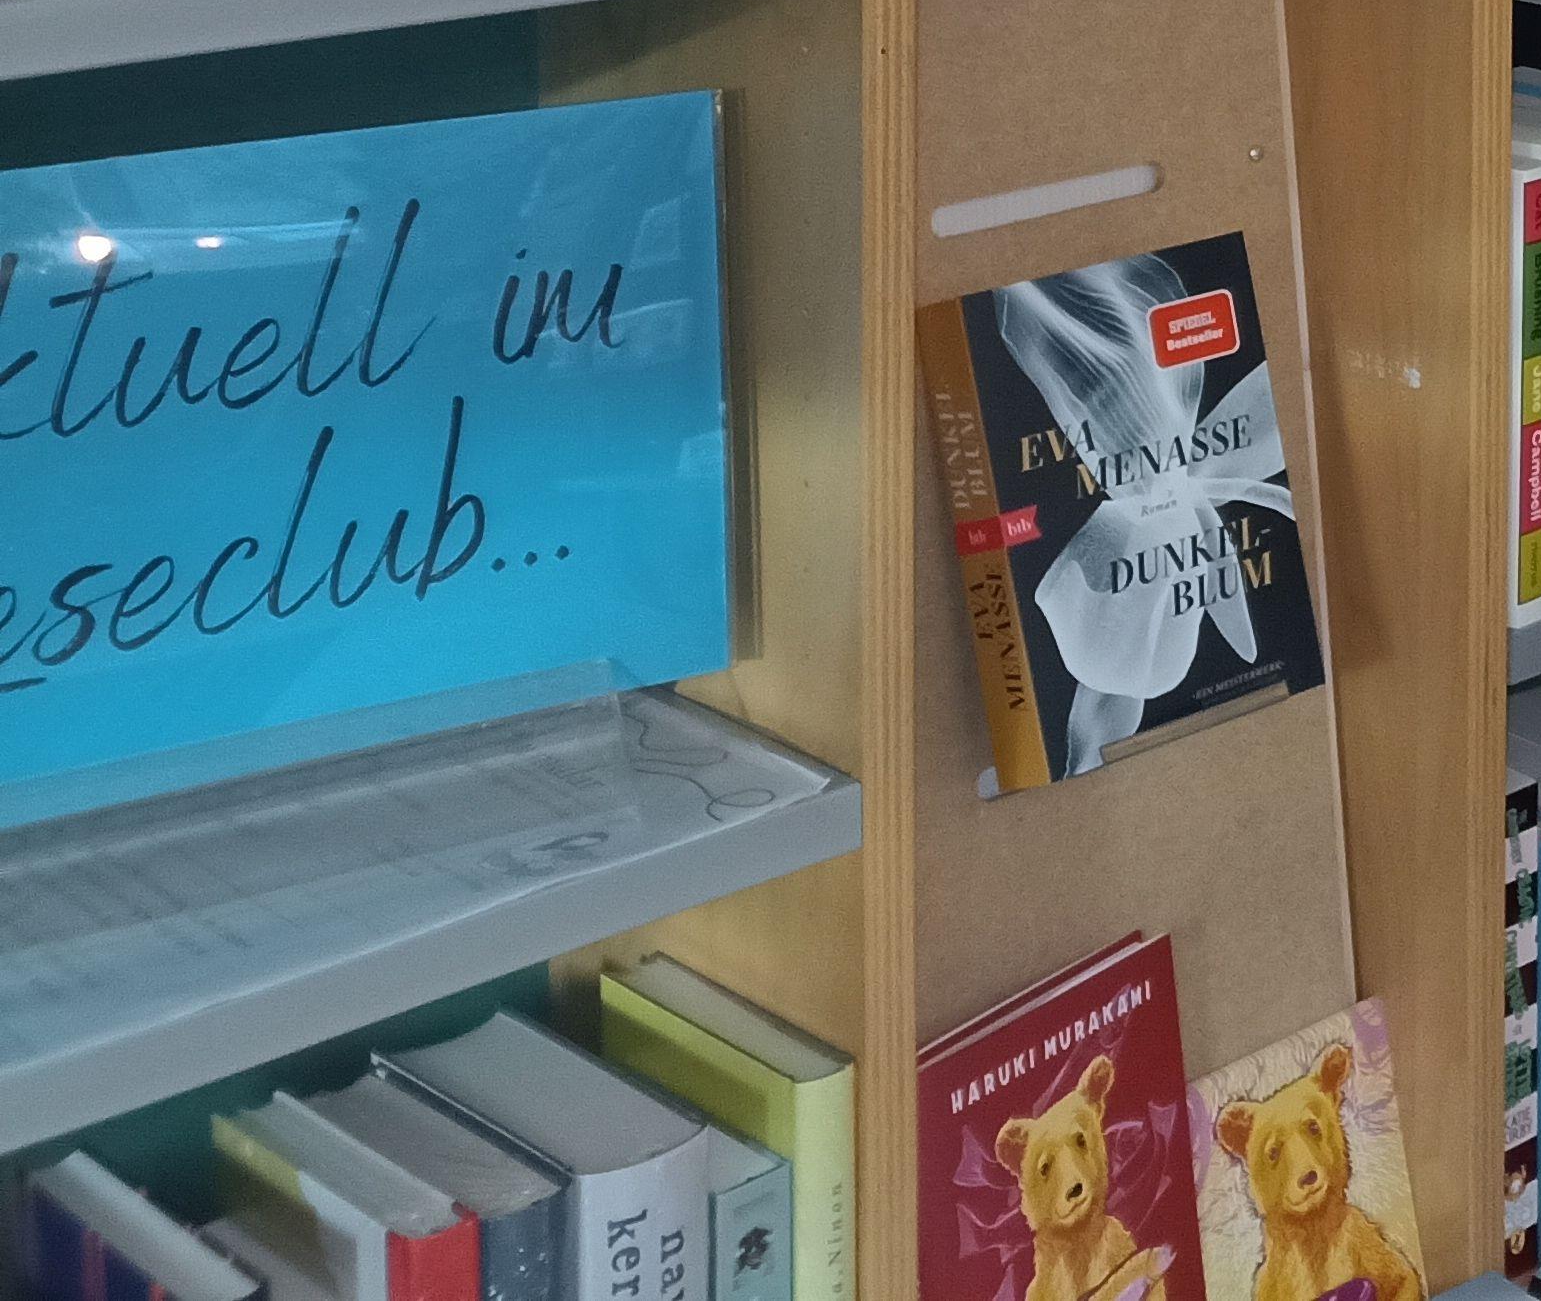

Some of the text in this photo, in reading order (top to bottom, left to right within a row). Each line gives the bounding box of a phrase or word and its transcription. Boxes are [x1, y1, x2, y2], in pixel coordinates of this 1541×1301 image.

[492, 247, 627, 365] im
[1020, 418, 1098, 473] EVA
[1077, 414, 1254, 501] MENASSE
[1109, 516, 1272, 595] DUNKEL-
[1172, 551, 1274, 618] BLUM
[950, 979, 1153, 1115] HARUKI MURAKAMI
